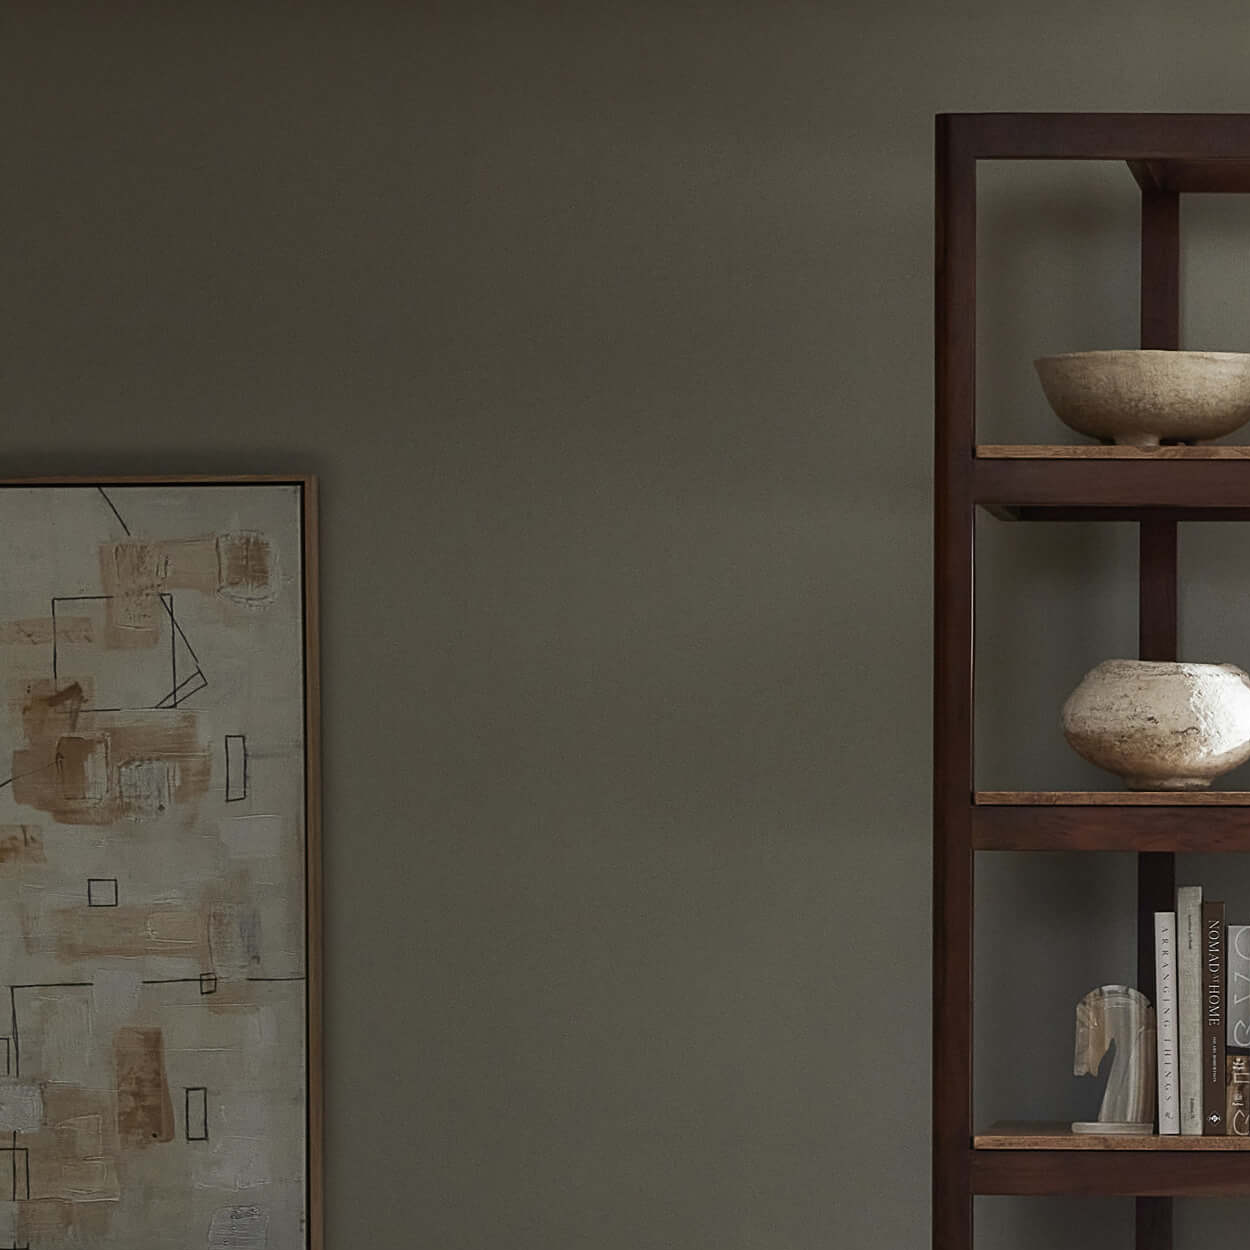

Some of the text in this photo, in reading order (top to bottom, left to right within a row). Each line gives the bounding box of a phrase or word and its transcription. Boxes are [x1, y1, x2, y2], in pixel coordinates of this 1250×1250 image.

[1209, 921, 1219, 972] NOMAD
[1160, 928, 1173, 1101] ARRANGING THINGS
[1209, 986, 1219, 1025] HOME
